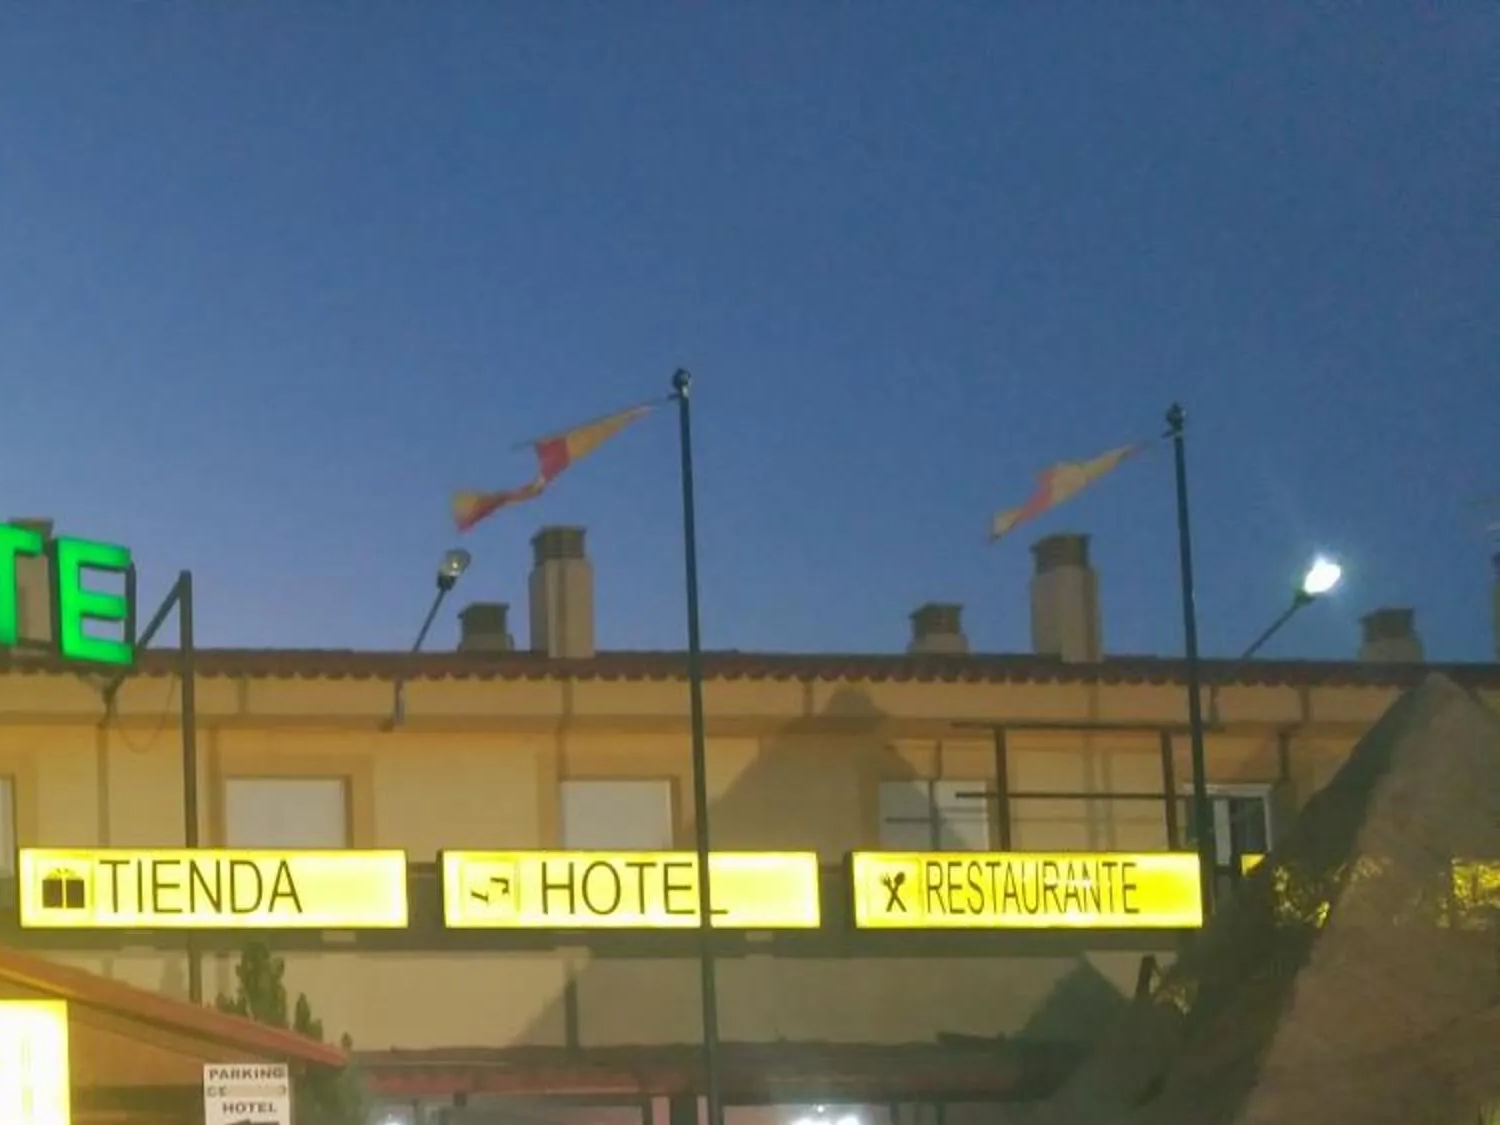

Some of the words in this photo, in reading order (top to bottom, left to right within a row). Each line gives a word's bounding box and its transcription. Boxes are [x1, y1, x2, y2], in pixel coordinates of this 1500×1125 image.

[100, 858, 303, 914] TIENDA
[925, 860, 1140, 914] RESTAURANTE
[208, 1066, 286, 1081] PARKING
[222, 1102, 277, 1115] HOTEL
